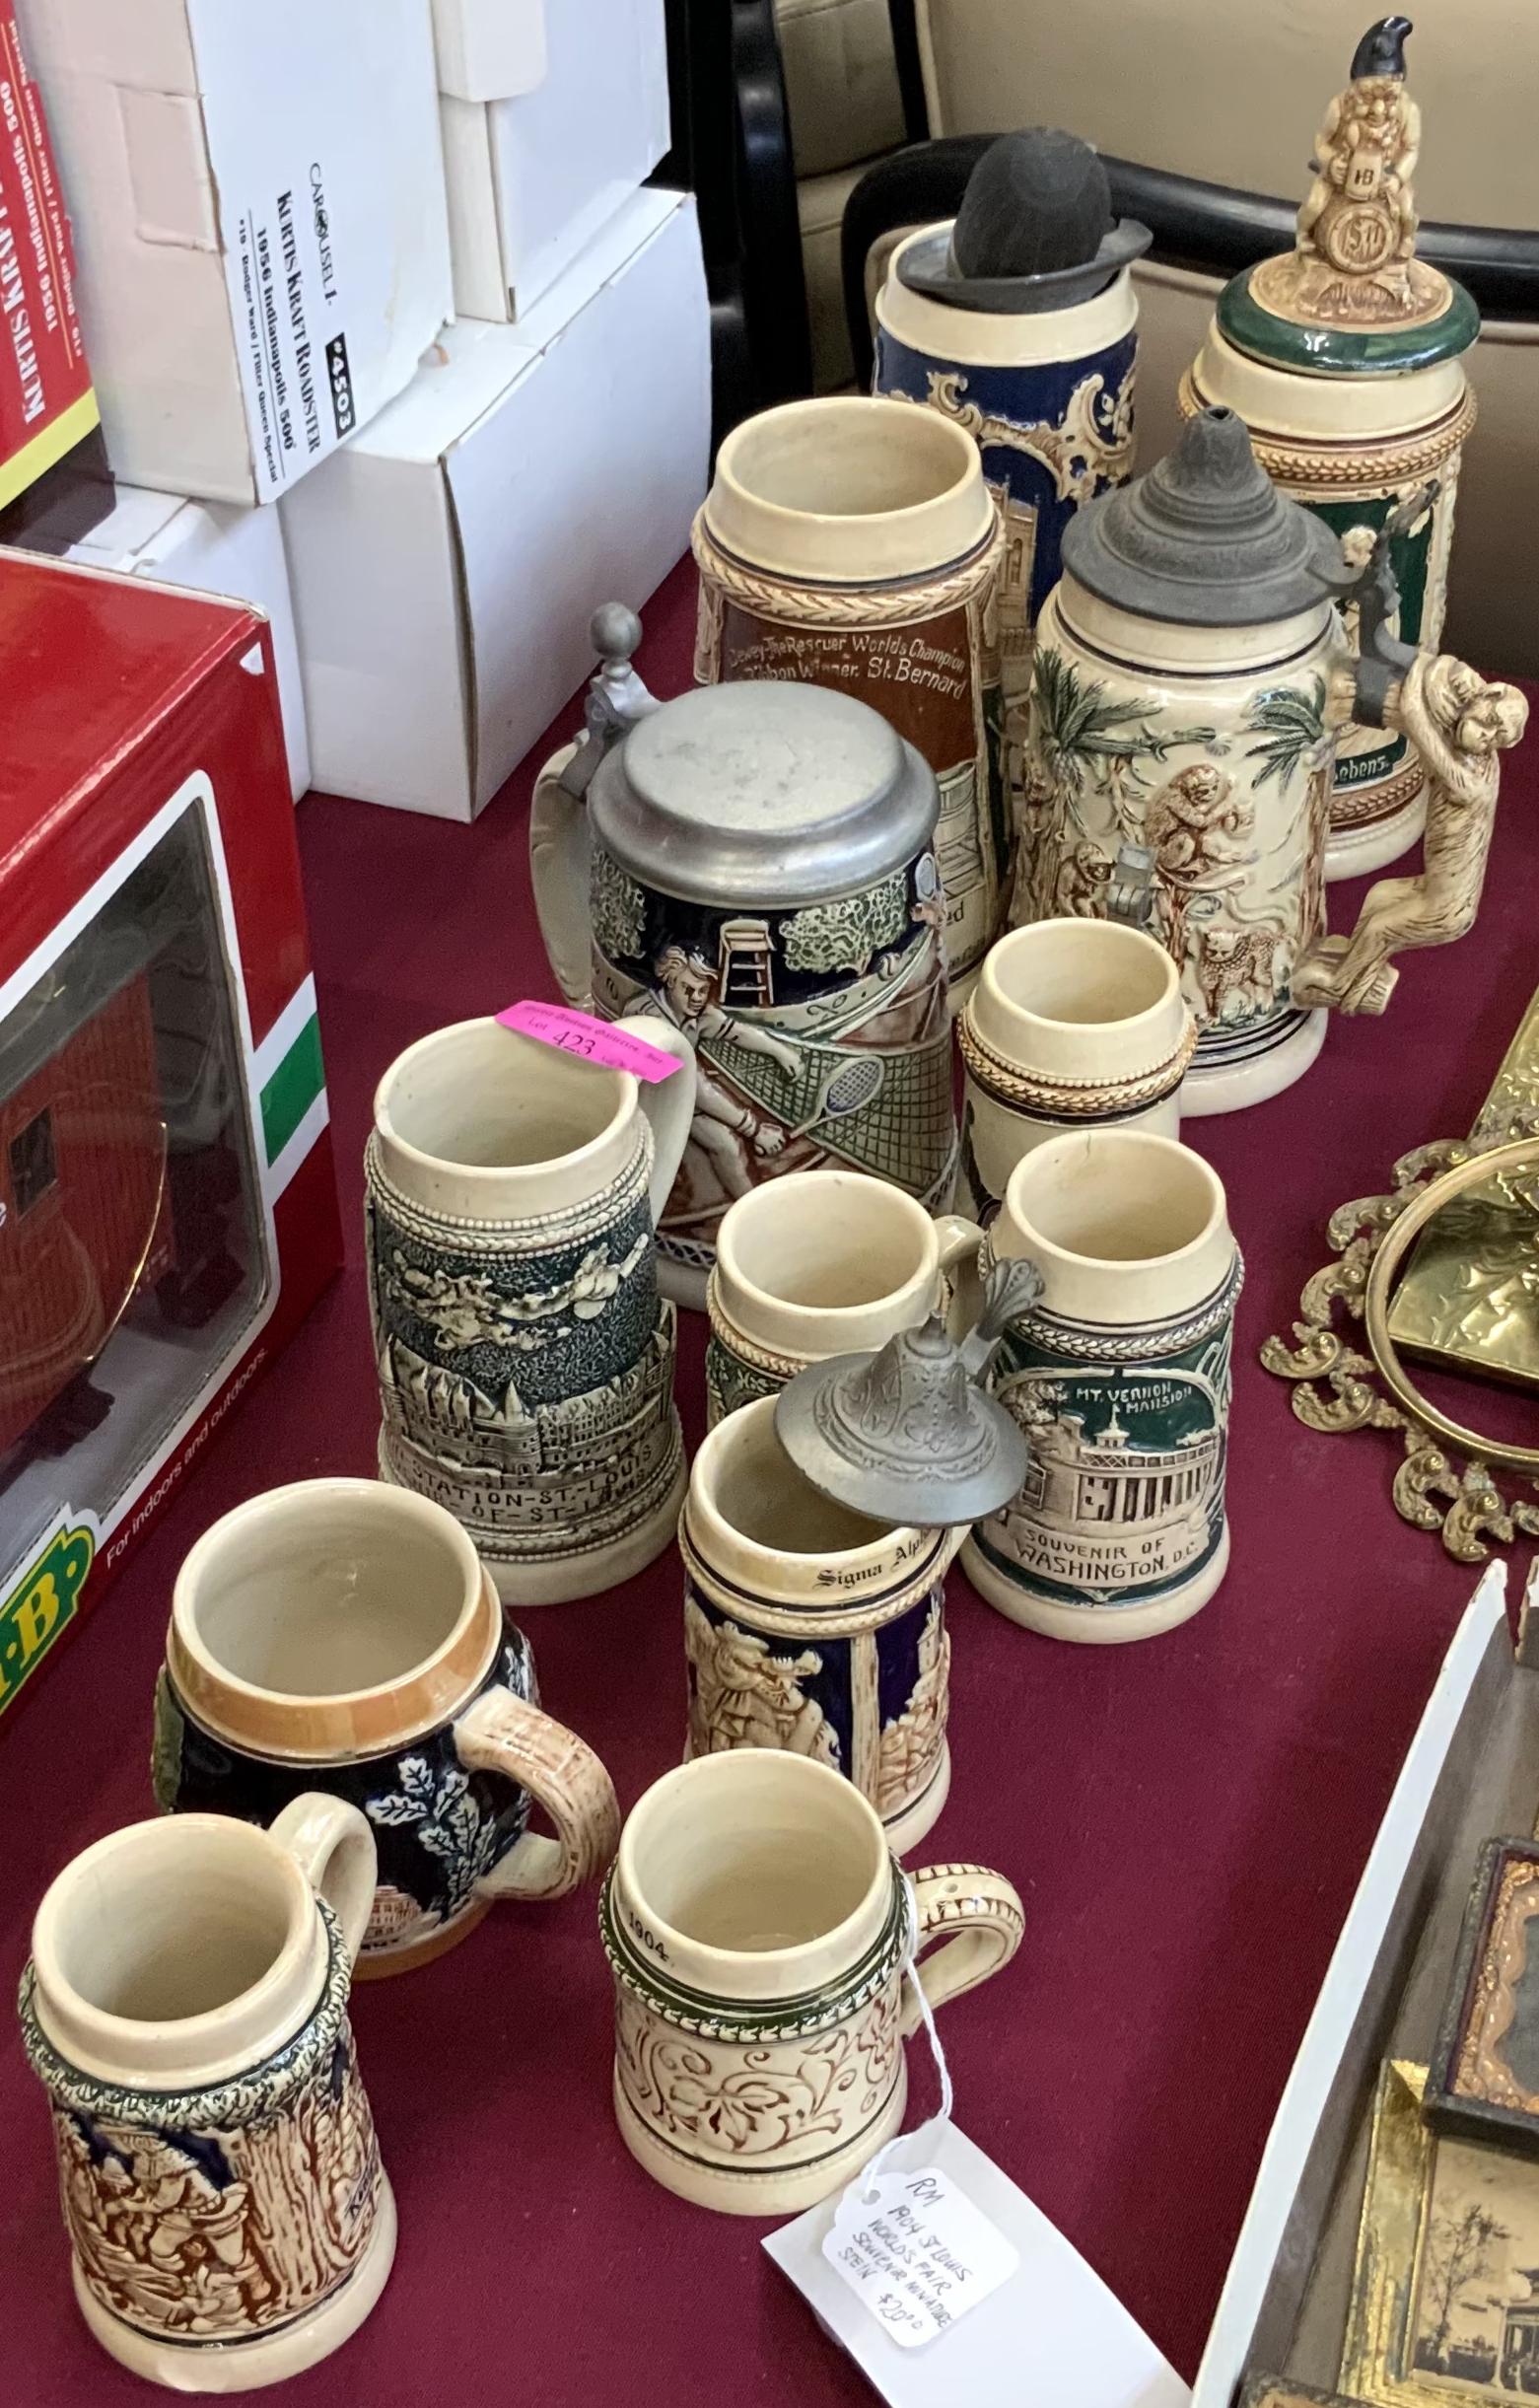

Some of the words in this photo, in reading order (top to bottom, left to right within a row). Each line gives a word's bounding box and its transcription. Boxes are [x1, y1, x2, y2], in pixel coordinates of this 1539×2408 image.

[12, 133, 48, 272] Indianapolis
[257, 227, 272, 282] 1956
[277, 190, 298, 272] KURTIS
[39, 274, 58, 333] 1956
[287, 270, 307, 341] KRAFT
[10, 308, 46, 424] KURTIS
[242, 254, 252, 303] Rodger
[247, 306, 258, 339] Ward
[257, 390, 269, 433] Queen
[263, 435, 278, 483] Special
[263, 285, 288, 406] Indianapolis
[296, 341, 321, 454] ROADSTER
[332, 341, 353, 430] #4503
[894, 658, 967, 699] Bernard
[909, 638, 965, 673] Champion
[552, 1030, 595, 1055] 423
[1107, 1381, 1171, 1402] VERNON
[1125, 1386, 1192, 1413] MANSION
[106, 1535, 130, 1569] For
[131, 1459, 183, 1533] indoors
[183, 1424, 210, 1465] and
[1024, 1529, 1128, 1559] SOUVENIR
[1141, 1537, 1165, 1555] OF
[1173, 1541, 1198, 1564] D.C.
[812, 1564, 883, 1590] Sigma
[629, 1911, 670, 1962] 1904
[905, 2177, 945, 2208] RM
[837, 2246, 877, 2280] STEIN
[887, 2205, 926, 2236] 1904
[930, 2247, 973, 2282] LOUIS
[915, 2261, 952, 2297] FAIR
